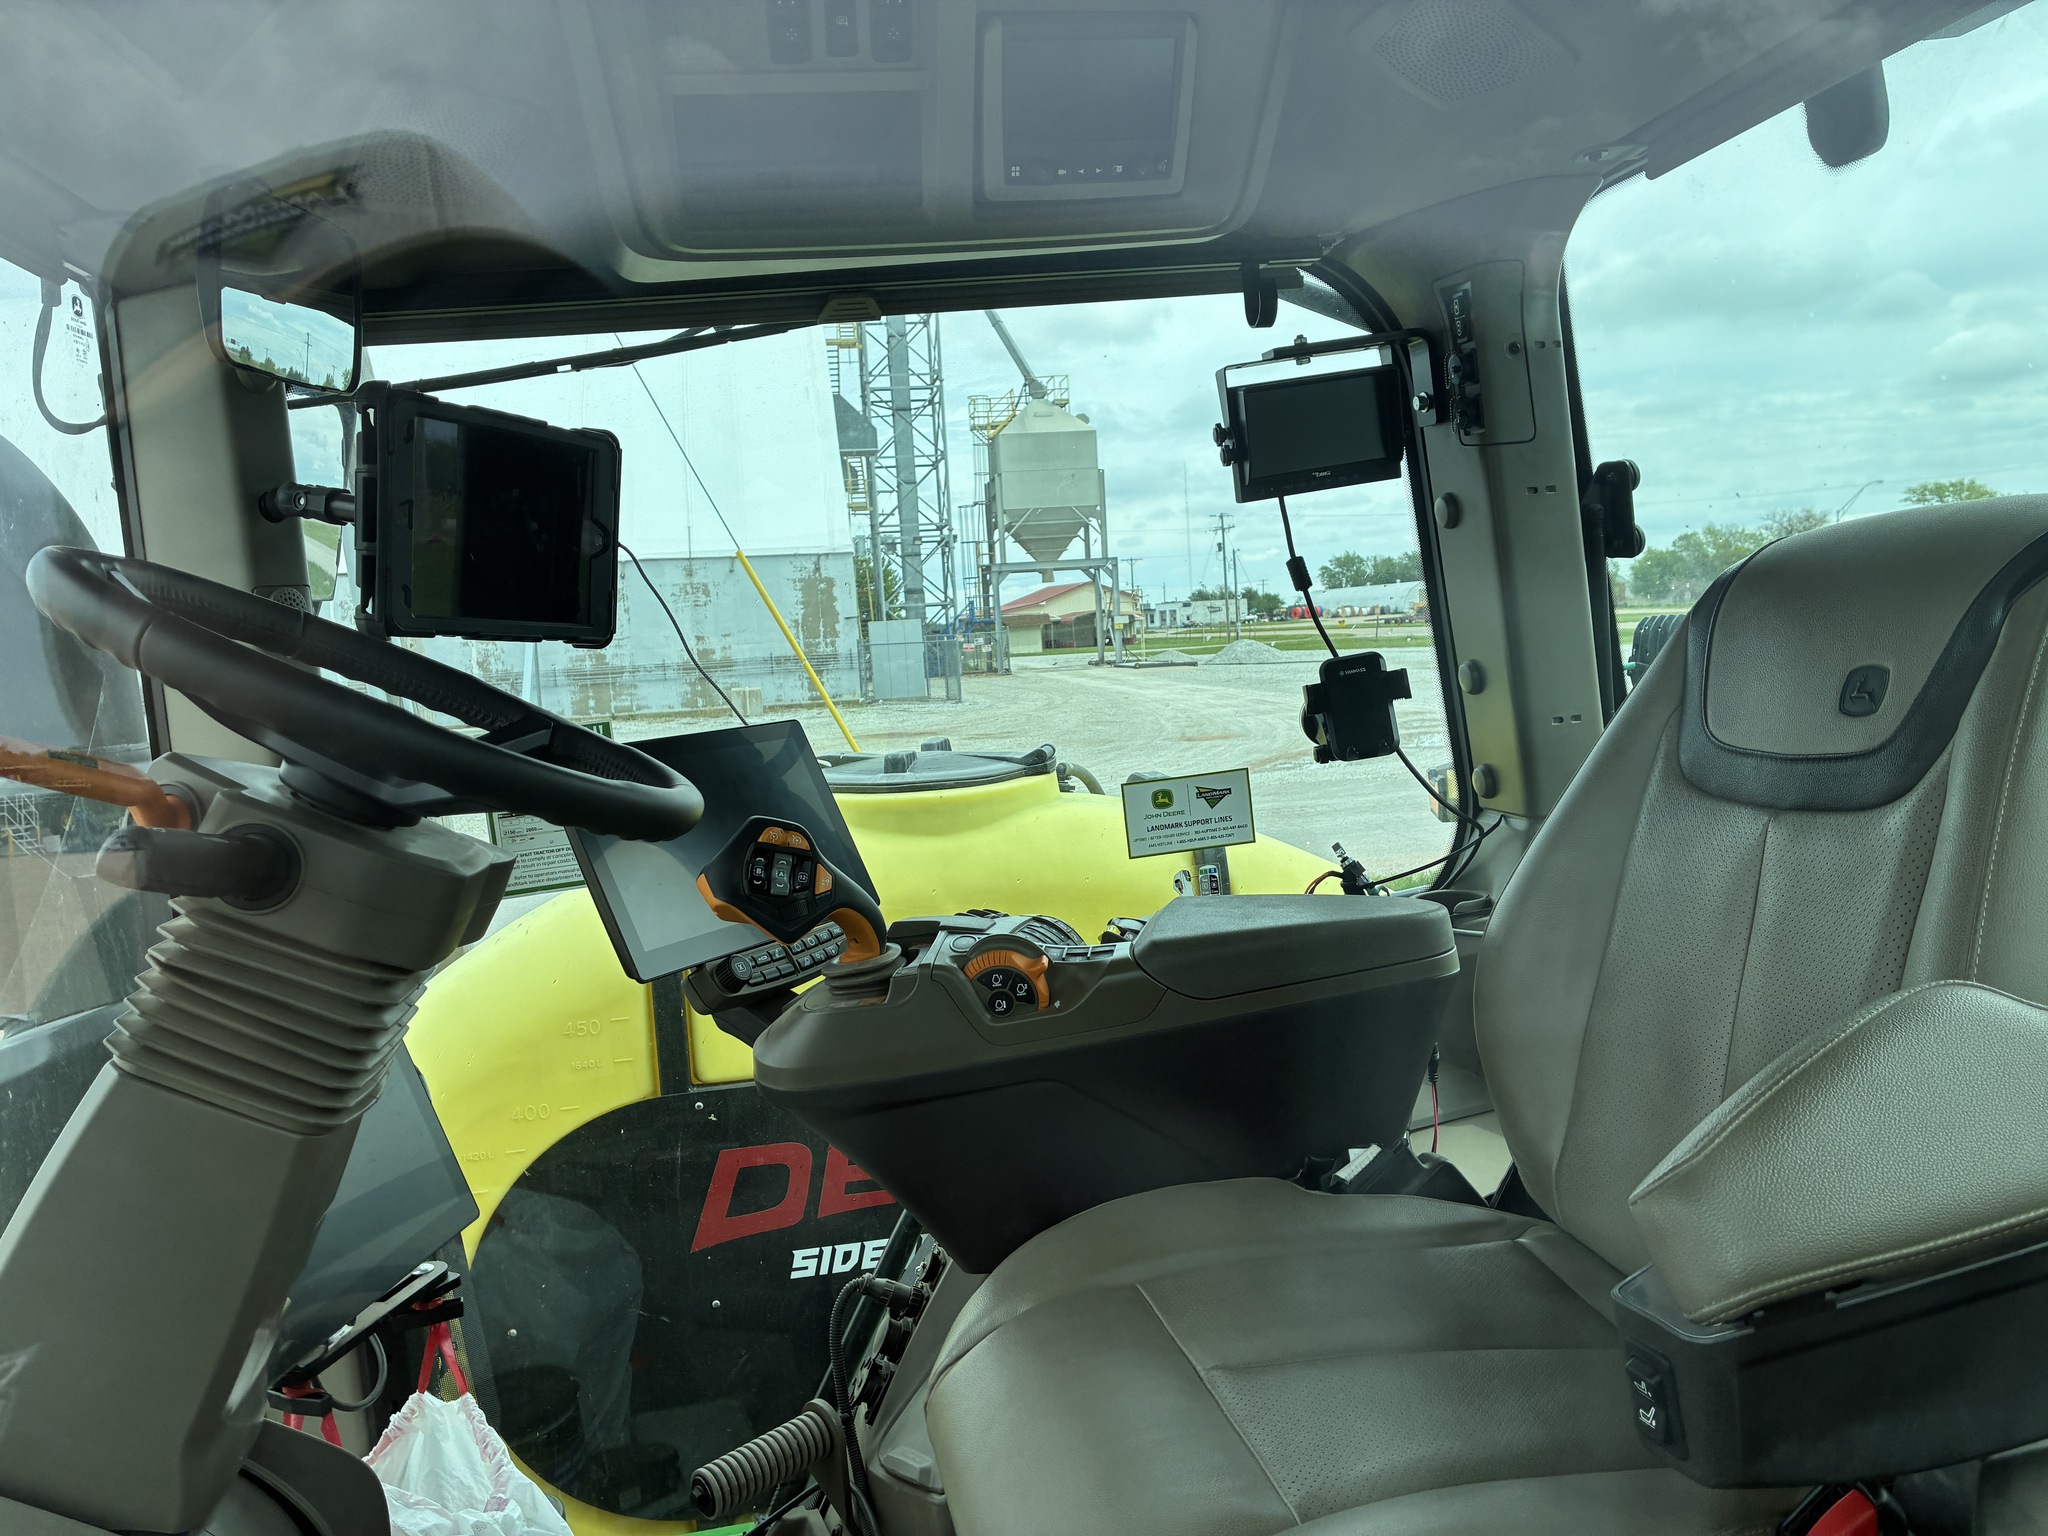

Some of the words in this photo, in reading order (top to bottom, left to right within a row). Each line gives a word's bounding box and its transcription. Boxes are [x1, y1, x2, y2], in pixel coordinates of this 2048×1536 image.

[1144, 812, 1162, 821] JOHN
[1163, 809, 1186, 818] DEERE
[1146, 821, 1184, 833] LANDMARK
[1184, 817, 1213, 828] SUPPORT
[1214, 815, 1233, 824] LINES
[533, 848, 555, 857] TRACTOR
[527, 856, 546, 864] comply
[542, 859, 557, 867] repair
[534, 870, 558, 879] operators
[545, 873, 574, 883] department
[563, 1018, 601, 1038] 450
[511, 1103, 550, 1123] 400
